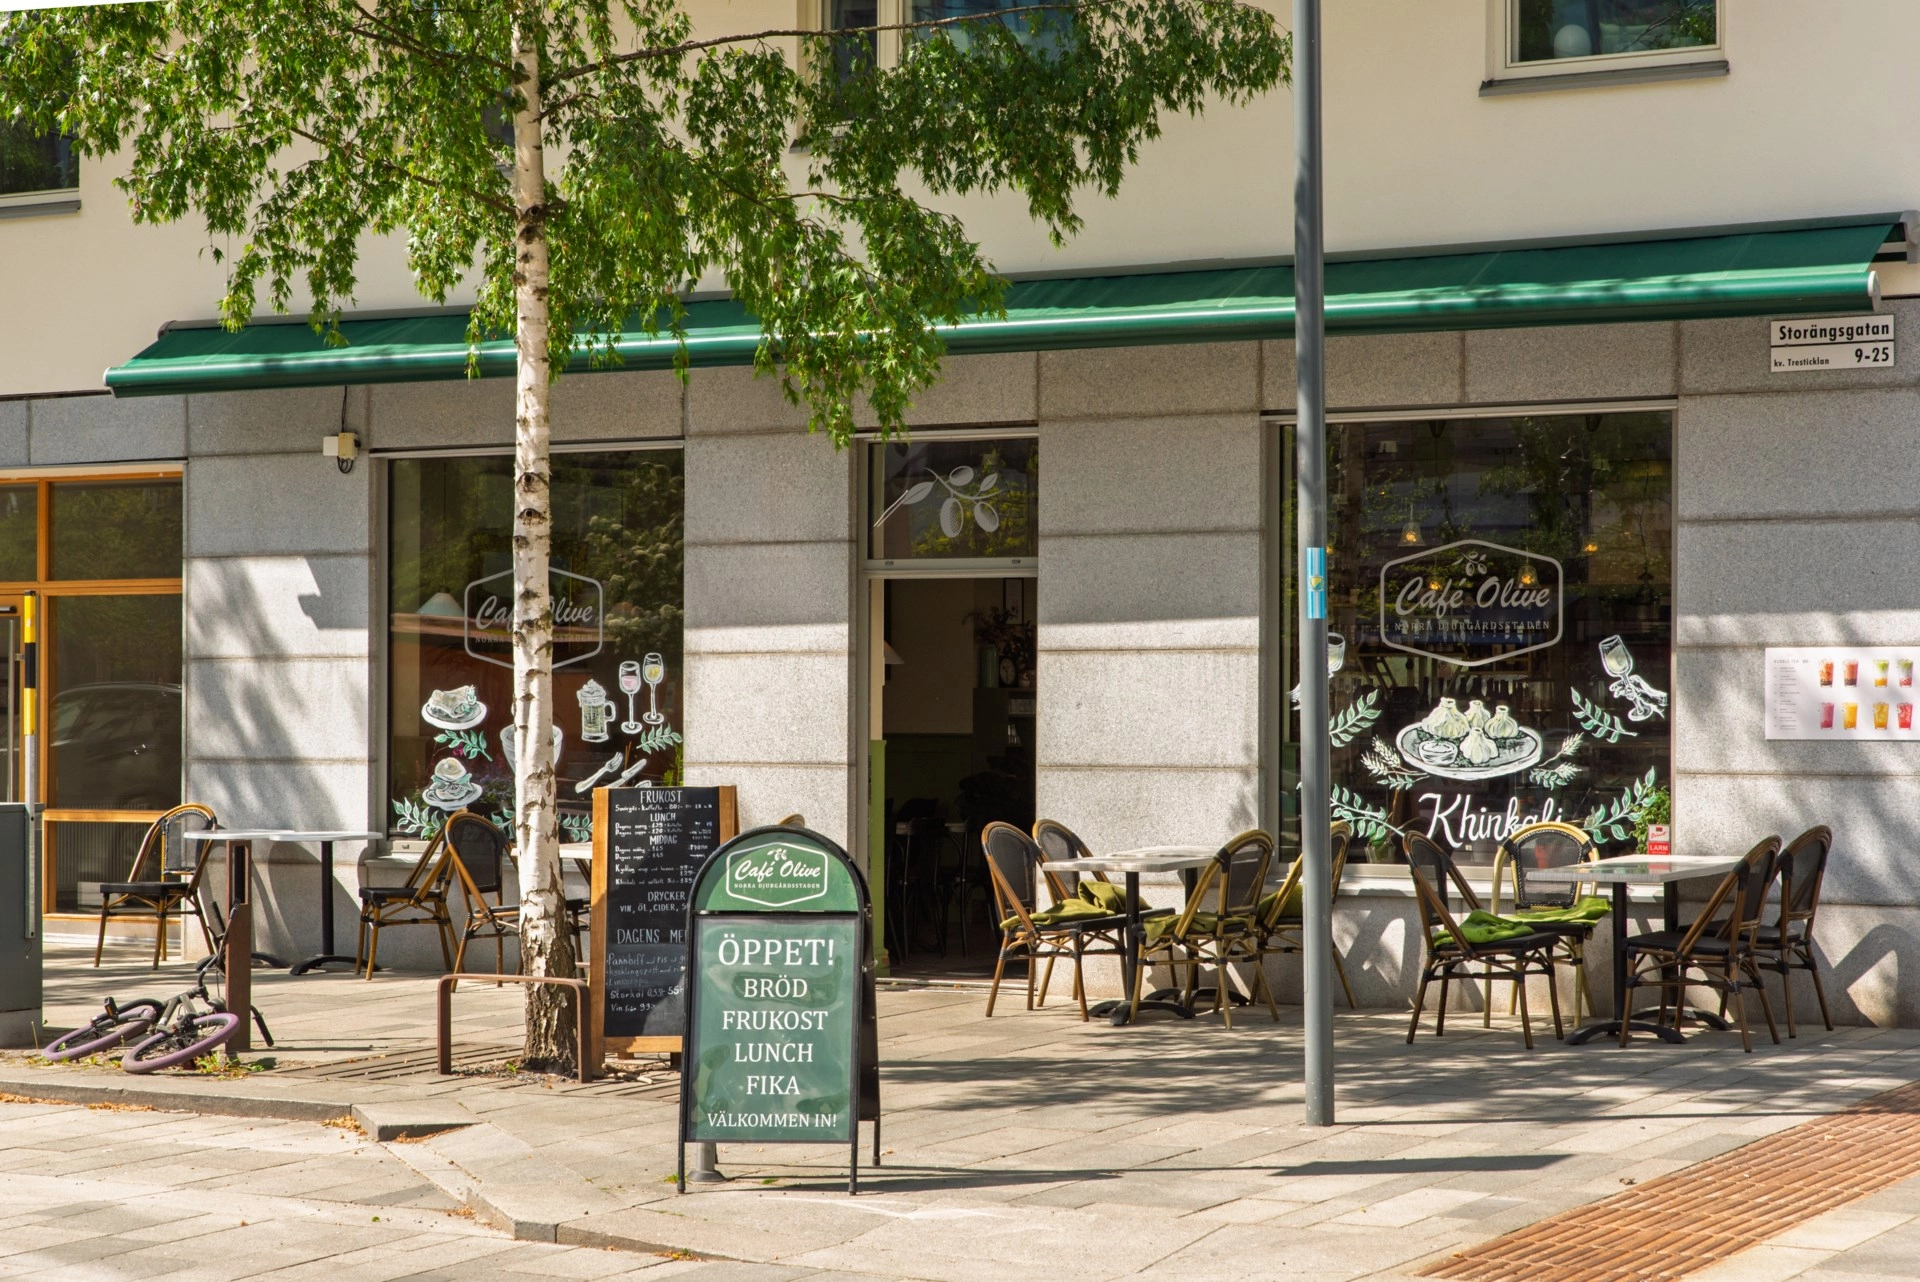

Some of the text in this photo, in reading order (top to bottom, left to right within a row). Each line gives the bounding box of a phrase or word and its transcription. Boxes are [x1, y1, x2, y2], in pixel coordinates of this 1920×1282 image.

[1779, 323, 1889, 342] Storängsgatan
[1774, 359, 1785, 367] kv.
[1855, 347, 1890, 363] 9-25
[1395, 576, 1550, 619] Café Olive
[475, 595, 593, 632] Ca live
[1394, 619, 1550, 631] NORRA DJURGÅRDSSTADEN
[640, 790, 682, 804] FRUKOST
[650, 812, 676, 822] LUNCH
[649, 835, 678, 845] MIDDAG
[735, 860, 820, 882] Café Olive
[758, 881, 820, 889] DJURGÅRDSSTADEN
[648, 891, 686, 901] DRYCKER
[617, 928, 660, 944] DAGENS
[718, 933, 834, 966] ÖPPET!
[743, 974, 808, 998] BRÖD
[611, 1003, 623, 1012] Vin
[722, 1010, 828, 1030] FRUKOST
[734, 1043, 814, 1063] LUNCH
[746, 1075, 801, 1095] FIKA
[707, 1110, 837, 1128] VÄLKOMMEN IN!
